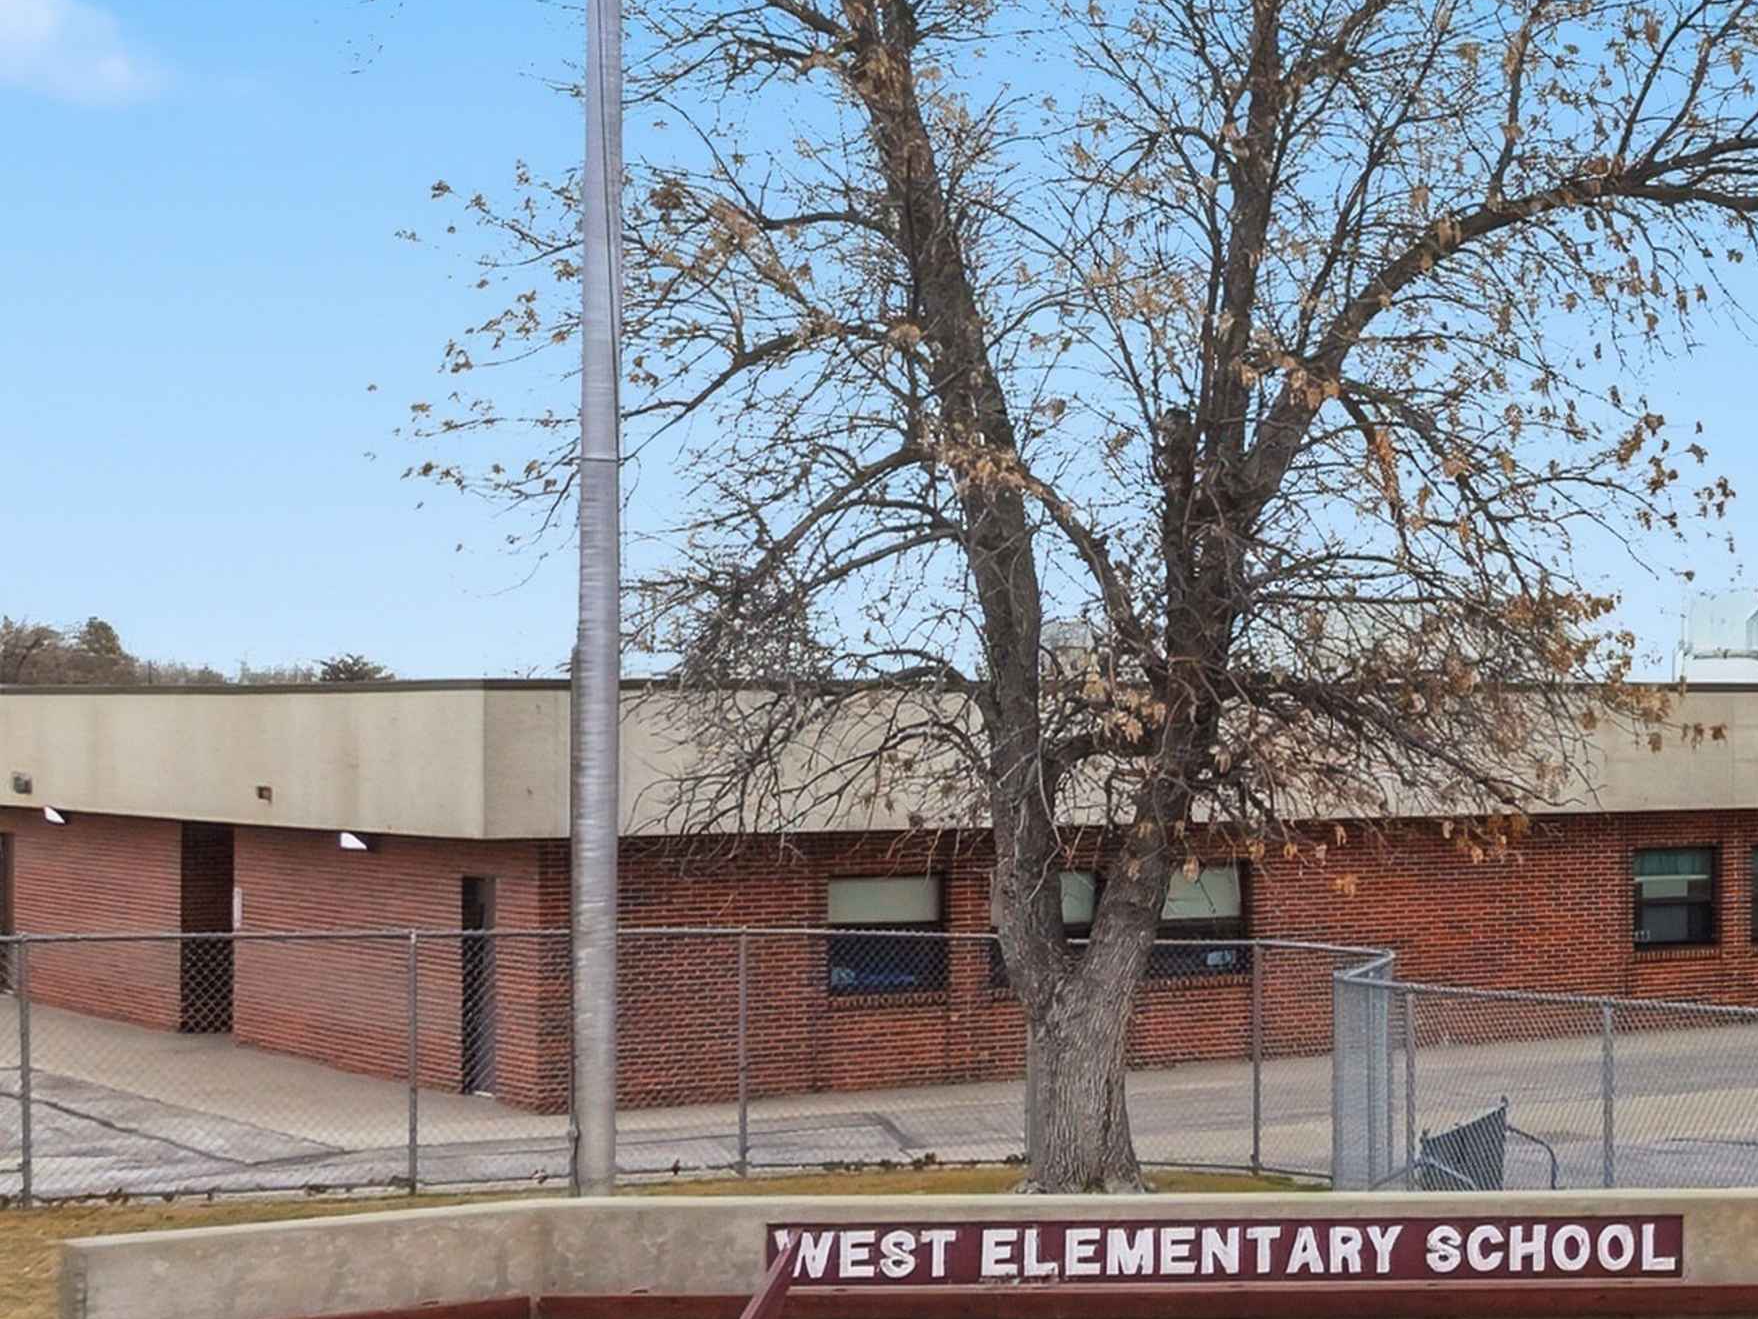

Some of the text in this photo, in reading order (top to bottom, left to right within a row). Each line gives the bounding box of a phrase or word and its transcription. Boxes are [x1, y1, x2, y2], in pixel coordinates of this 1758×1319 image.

[774, 1223, 1677, 1279] WEST ELEMENTARY SCHOOL
